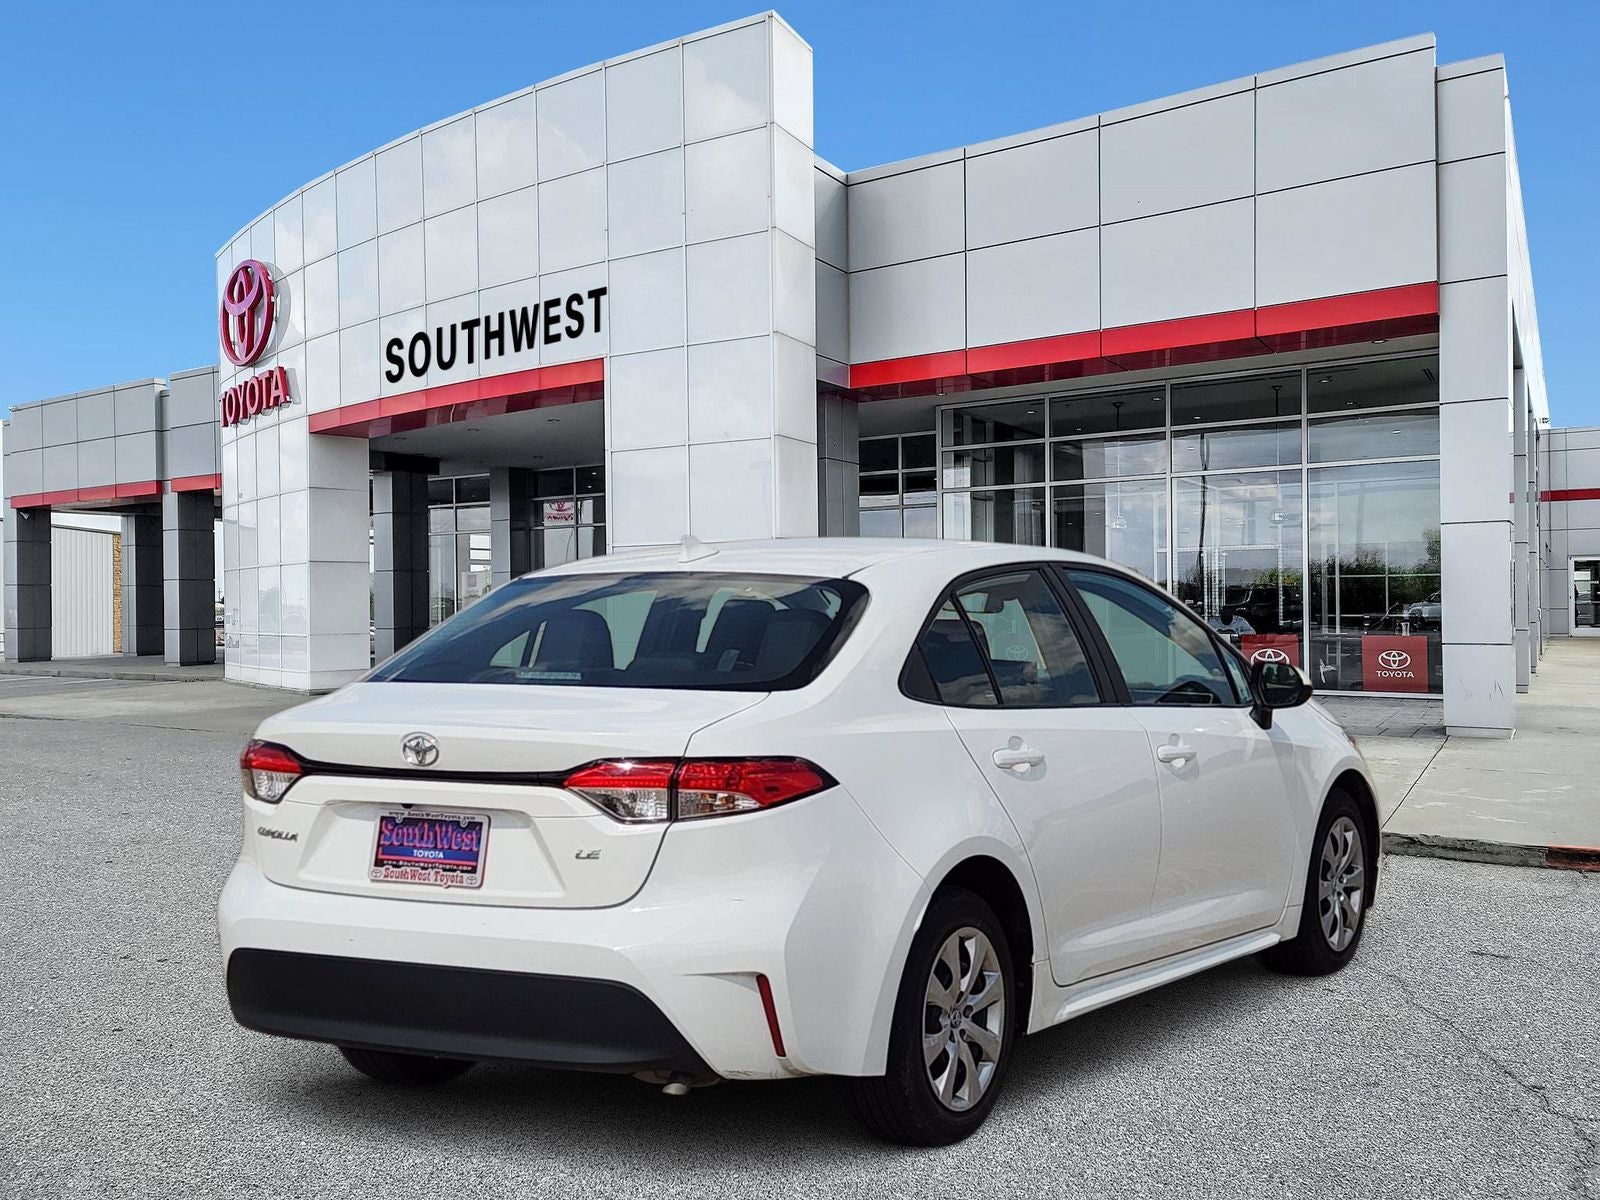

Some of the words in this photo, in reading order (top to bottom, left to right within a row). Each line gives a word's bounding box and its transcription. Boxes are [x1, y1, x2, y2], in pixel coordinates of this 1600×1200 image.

[385, 286, 608, 383] SOUTHWEST
[219, 366, 290, 427] TOYOTA
[1375, 670, 1415, 679] TOYOTA
[412, 849, 444, 859] TOYOTA
[575, 848, 602, 860] LE
[383, 866, 431, 882] SouthWest
[433, 870, 465, 886] Toyota
